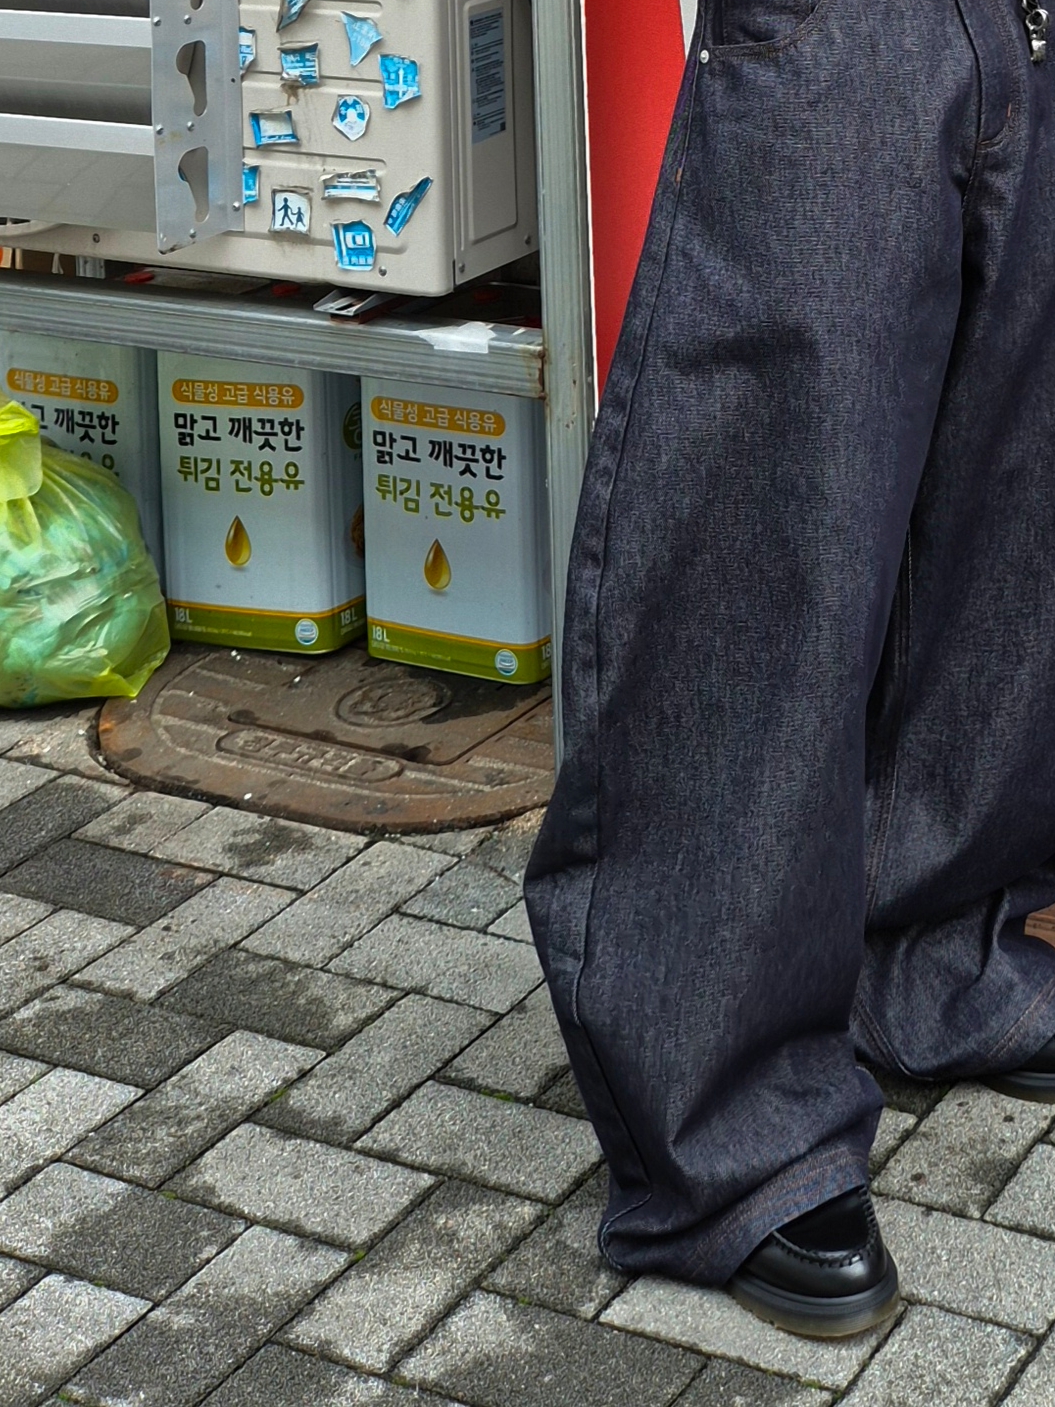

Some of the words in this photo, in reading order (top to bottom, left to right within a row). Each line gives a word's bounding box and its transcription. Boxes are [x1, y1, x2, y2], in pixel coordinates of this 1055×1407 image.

[14, 370, 47, 394] 식물성
[50, 374, 72, 396] 고급
[75, 378, 112, 401] 식용유
[180, 382, 219, 403] 식물성
[222, 383, 249, 404] 고급
[253, 383, 296, 406] 식용유
[53, 407, 120, 445] 깨끗한
[173, 412, 222, 447] 맑고
[228, 416, 305, 453] 깨끗한
[378, 398, 419, 423] 식물성
[422, 405, 450, 428] 고급
[453, 409, 498, 433] 식용유
[372, 429, 422, 466] 맑고
[428, 439, 507, 481] 깨끗한
[176, 455, 222, 492] 튀김
[229, 459, 305, 497] 전용유
[375, 473, 421, 514] 튀김
[429, 481, 507, 524] 전용유
